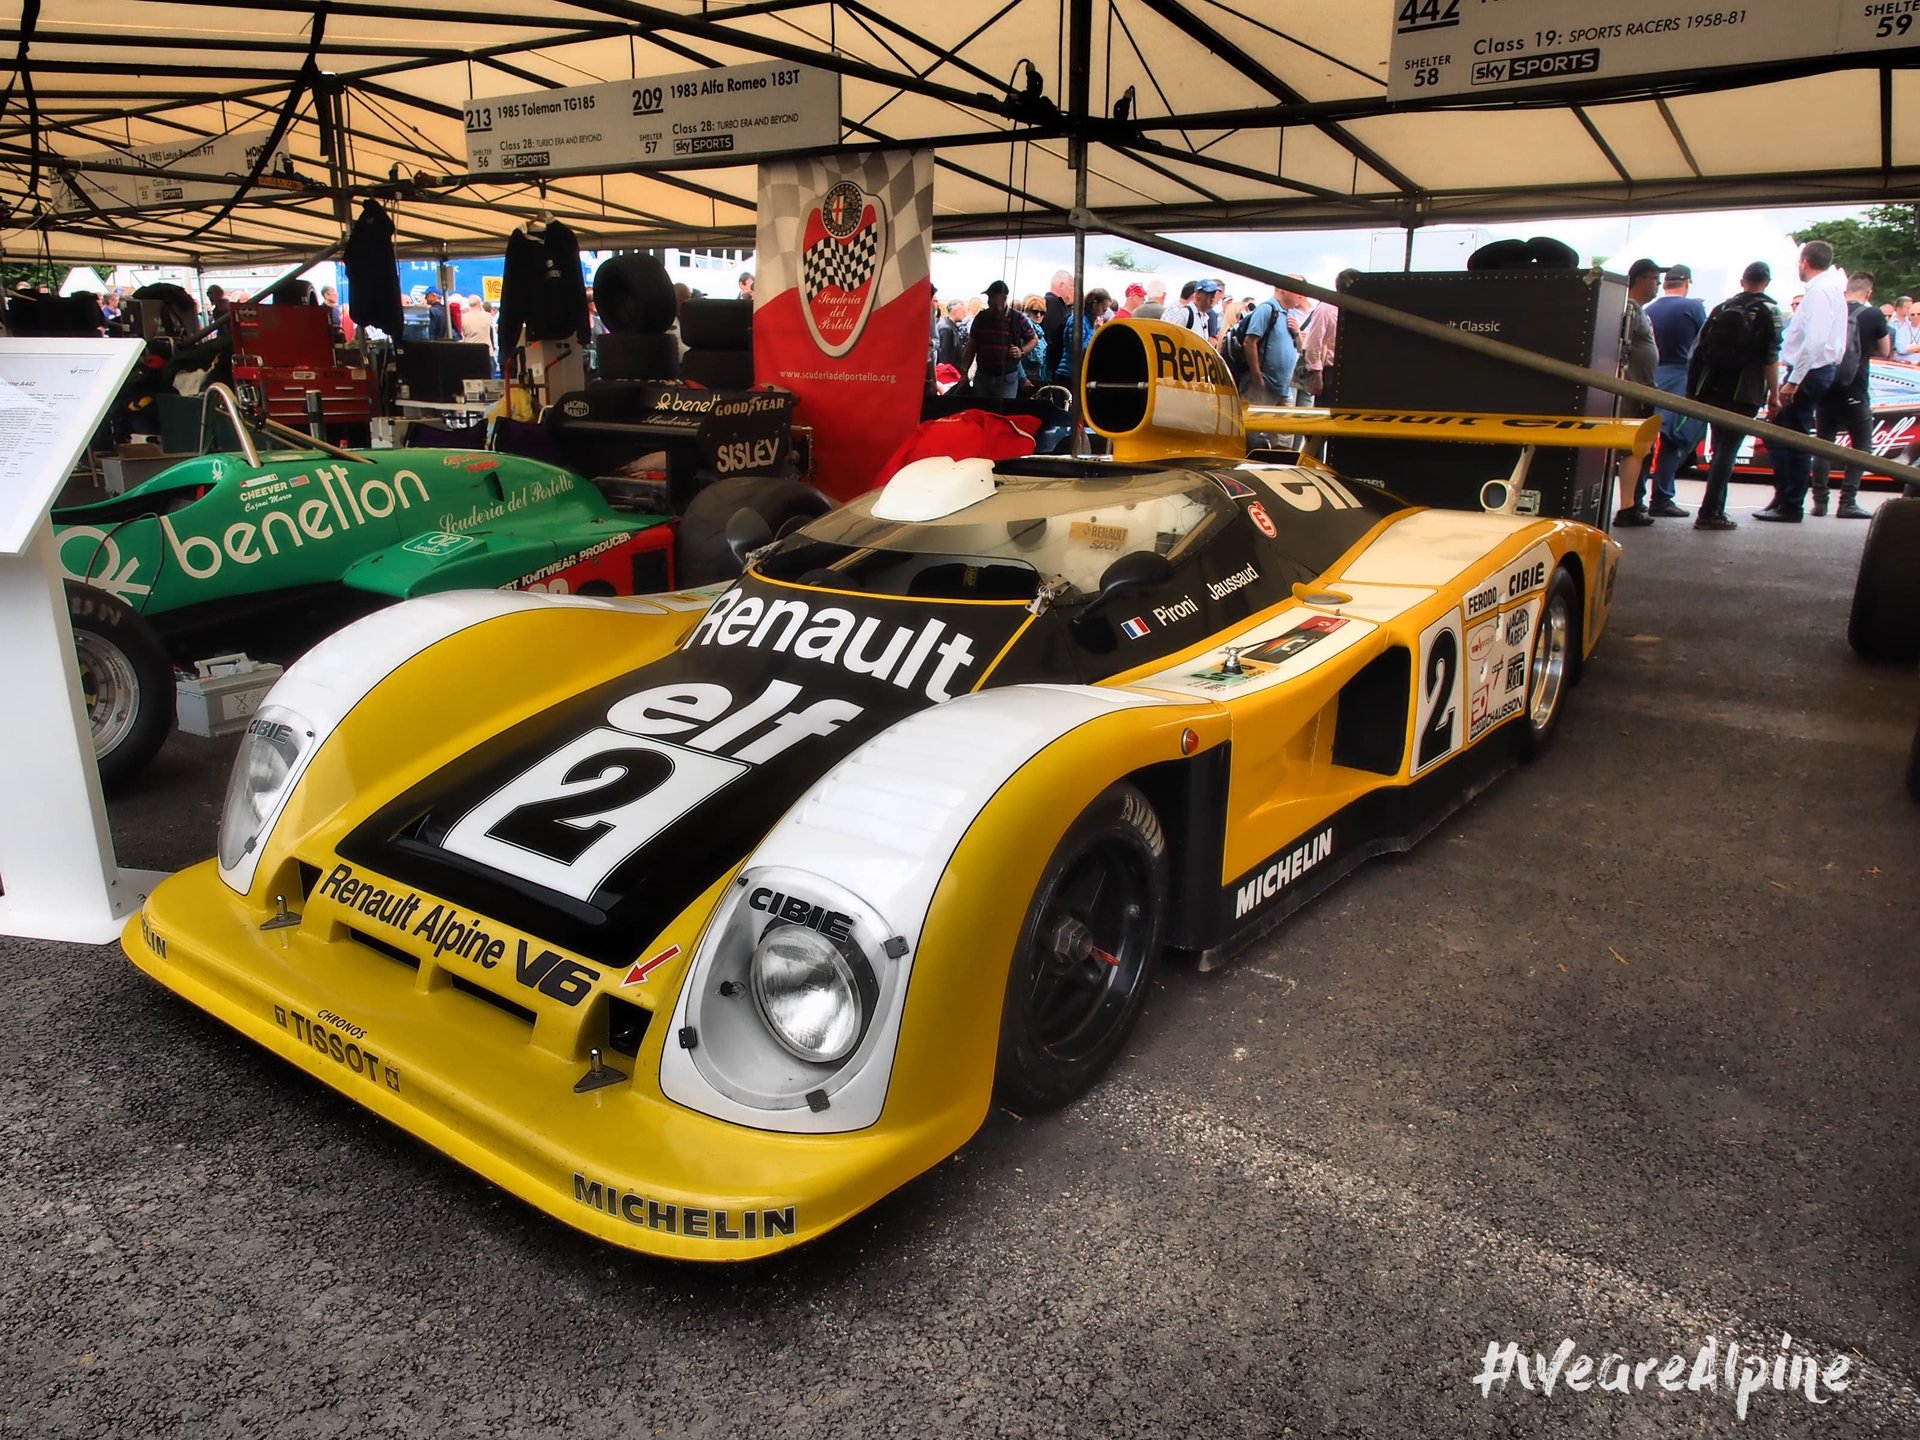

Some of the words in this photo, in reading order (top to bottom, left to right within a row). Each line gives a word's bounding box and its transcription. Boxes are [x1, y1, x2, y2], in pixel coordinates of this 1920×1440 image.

[1864, 0, 1920, 16] SHELTE
[1473, 33, 1525, 56] Class
[1532, 29, 1563, 49] 19:
[1568, 24, 1622, 44] SPORTS
[1626, 17, 1681, 38] RACERS
[1686, 10, 1747, 30] 1958-81
[1876, 13, 1913, 38] 59
[1404, 54, 1452, 70] SHELTER
[1474, 62, 1505, 83] sky
[1512, 52, 1596, 77] SPORTS
[670, 83, 698, 99] 1983
[701, 79, 725, 96] Alfa
[727, 76, 767, 93] Romeo
[770, 70, 800, 86] 183T
[1413, 67, 1440, 88] 58
[497, 104, 520, 120] 1985
[522, 102, 562, 117] Toleman
[563, 95, 595, 112] TG185
[632, 87, 663, 112] 209
[466, 108, 492, 129] 213
[672, 122, 698, 135] Class
[700, 120, 715, 133] 28:
[716, 118, 739, 130] TURBO
[740, 117, 752, 128] ERA
[753, 115, 770, 127] AND
[770, 113, 799, 125] BEYOND
[500, 140, 520, 151] Class
[521, 138, 535, 150] 28:
[536, 137, 554, 147] TURBO
[565, 135, 578, 145] AND
[578, 133, 603, 144] BEYOND
[639, 133, 663, 142] SHELTER
[645, 141, 658, 155] 57
[674, 139, 691, 154] sky
[692, 136, 733, 151] SPORTS
[149, 151, 162, 162] 1985
[202, 145, 214, 156] 97T
[478, 156, 489, 168] 56
[502, 156, 517, 169] sky
[518, 153, 549, 166] SPORTS
[142, 191, 148, 200] 55
[163, 189, 182, 199] SPORTS
[818, 291, 861, 305] Scuderia
[819, 319, 853, 331] Portello
[829, 307, 845, 318] del
[1459, 320, 1501, 333] Classic
[780, 369, 896, 383] www.scuderiadelportello.org
[715, 396, 785, 417] GOODYEAR
[717, 437, 780, 473] SISLEY
[240, 481, 288, 502] CHEEVER
[440, 503, 503, 535] Scuderia
[508, 487, 527, 512] del
[531, 474, 574, 501] Portello
[161, 464, 430, 579] benetton
[499, 580, 518, 591] EST
[522, 553, 576, 586] KNITWEAR
[579, 532, 631, 560] PRODUCER
[1207, 562, 1260, 600] Jaussaud
[1153, 594, 1199, 627] Pironi
[1468, 587, 1497, 615] FERODO
[678, 588, 974, 703] Renault
[1417, 627, 1457, 772] 2
[1486, 695, 1523, 729] CHAUSSON
[606, 679, 865, 765] elf
[484, 747, 676, 867] 2
[1235, 827, 1332, 919] MICHELIN
[319, 863, 422, 929] Renault
[412, 905, 506, 969] Alpine
[515, 938, 601, 1007] V6
[317, 1009, 368, 1040] CHRONOS
[290, 1011, 379, 1082] TISSOT
[573, 1171, 797, 1241] MICHELIN
